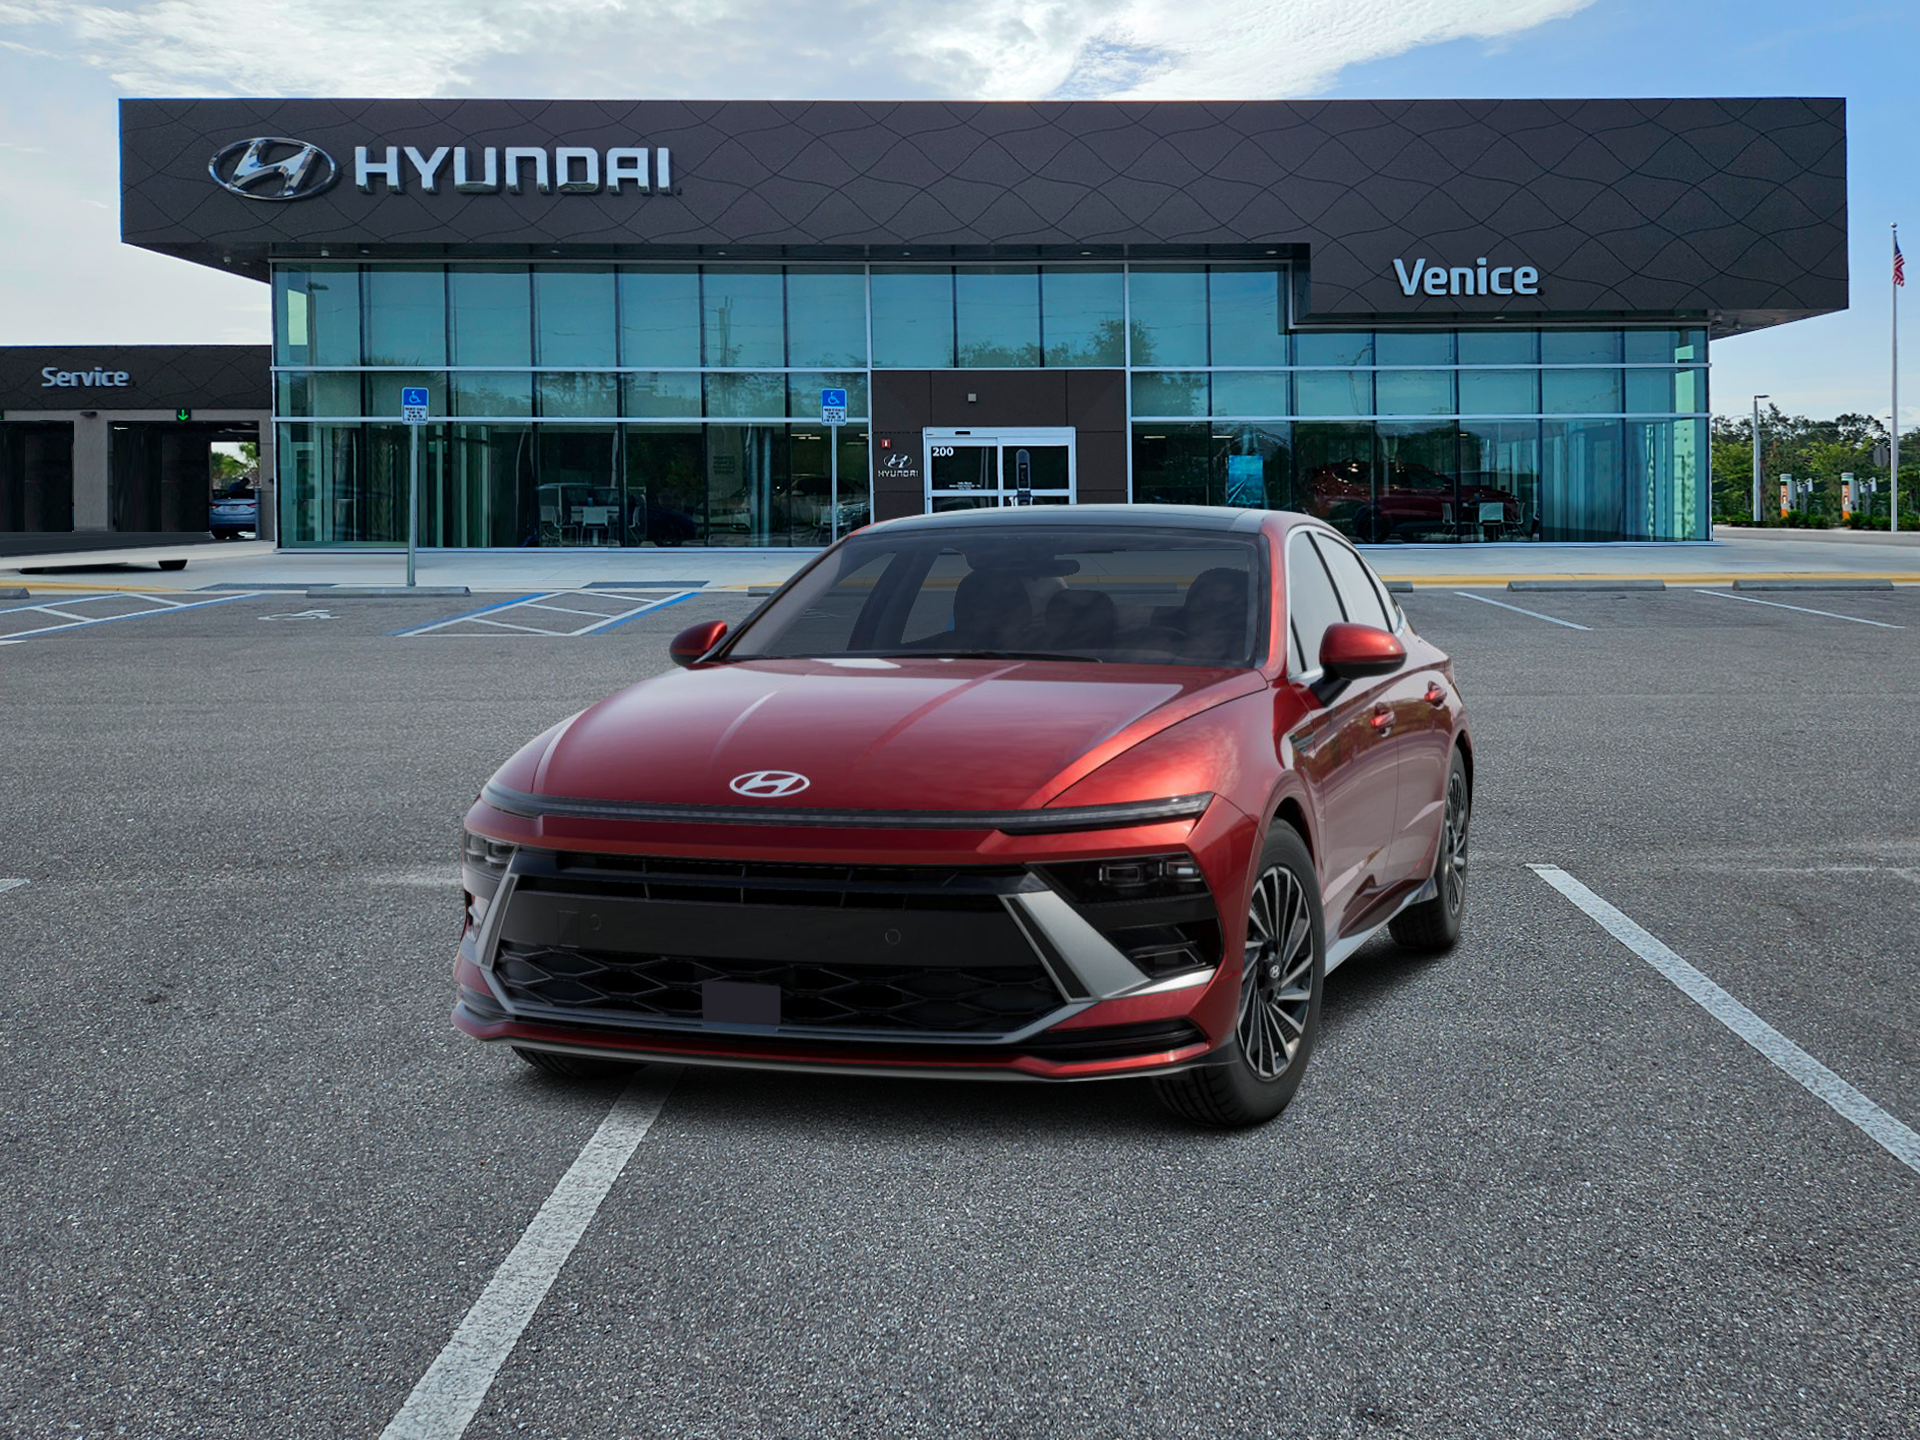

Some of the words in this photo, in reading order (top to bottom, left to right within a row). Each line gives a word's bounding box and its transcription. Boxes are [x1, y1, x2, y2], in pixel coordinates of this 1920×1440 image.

[354, 146, 670, 194] HYUNDAI
[1393, 257, 1538, 295] Venice
[41, 366, 130, 387] Service
[932, 447, 954, 457] 200
